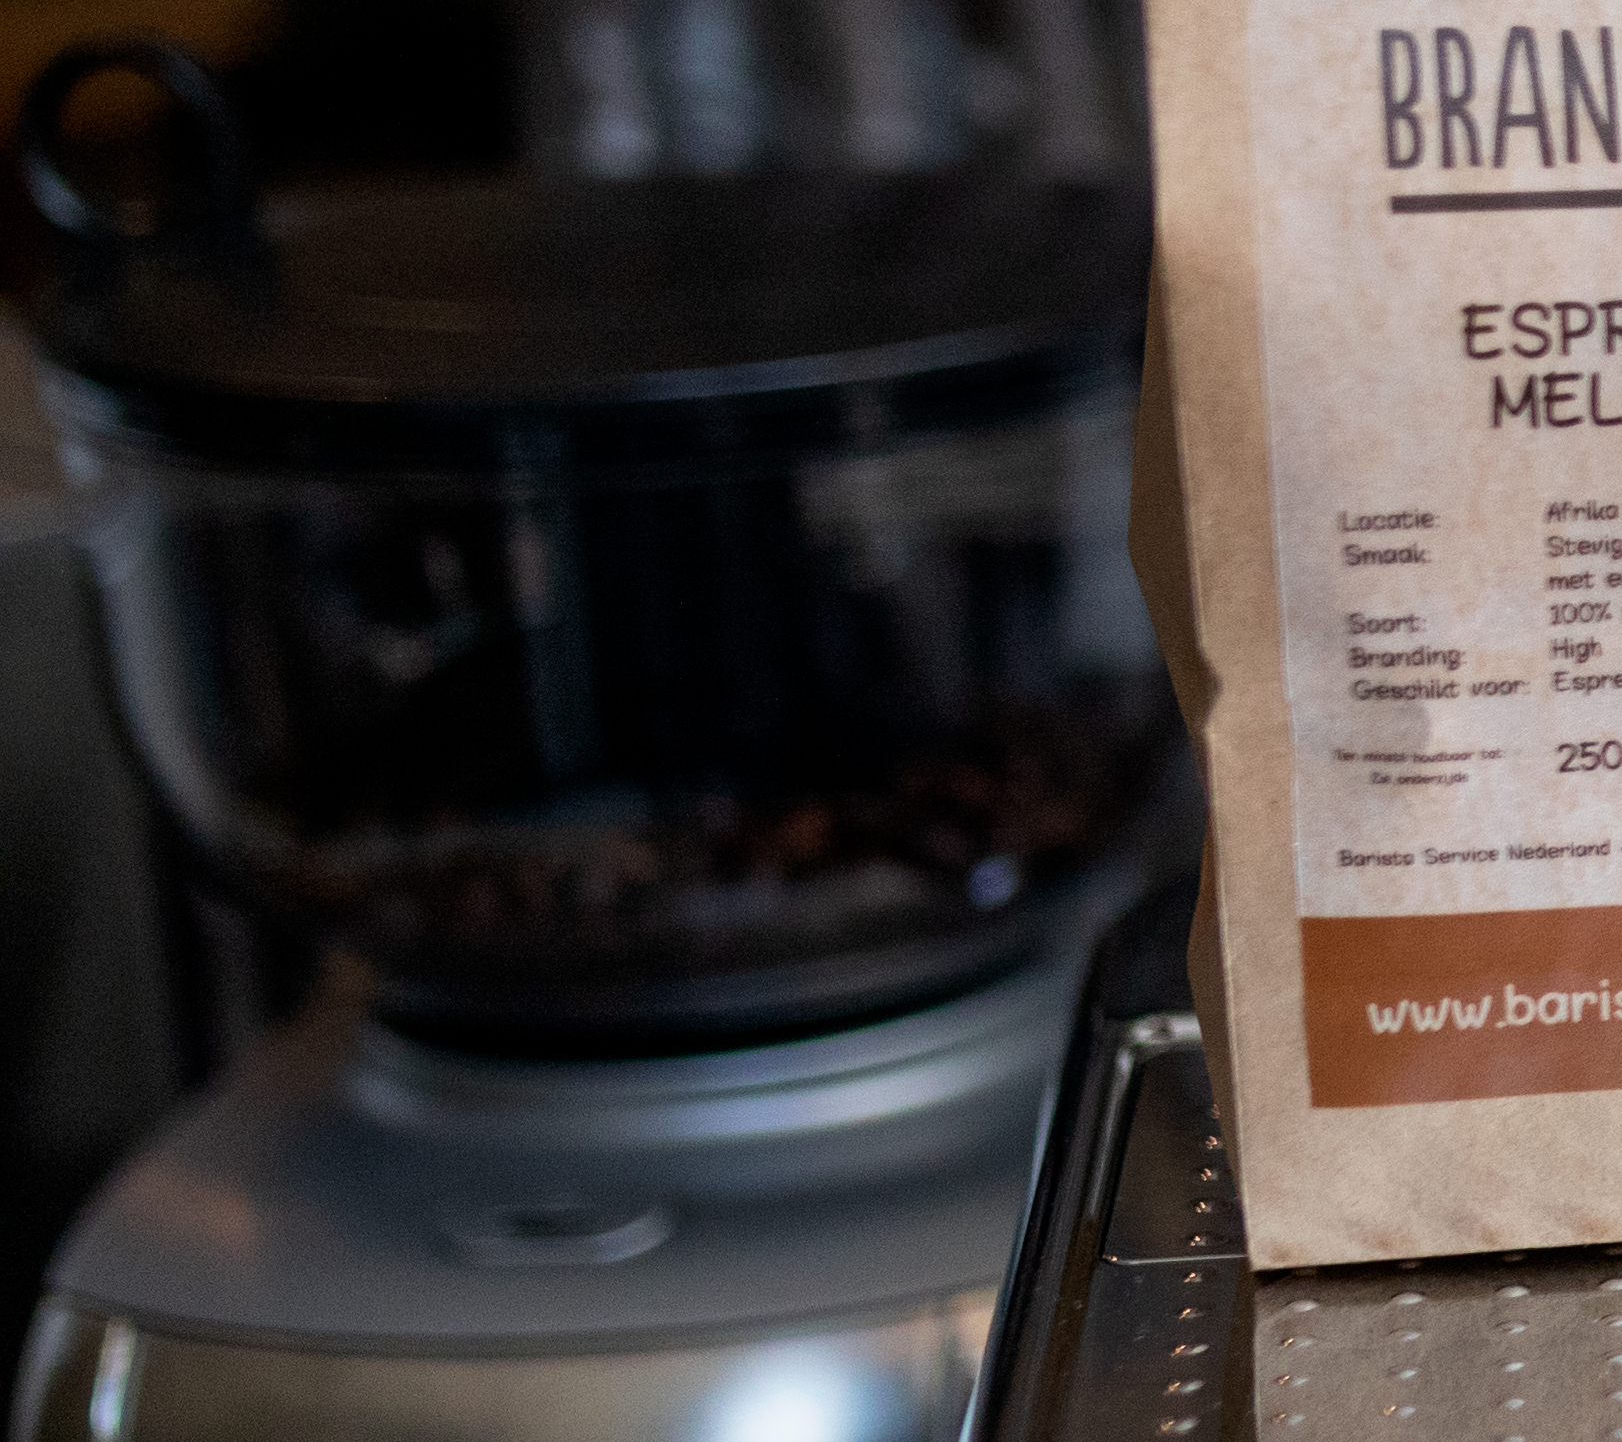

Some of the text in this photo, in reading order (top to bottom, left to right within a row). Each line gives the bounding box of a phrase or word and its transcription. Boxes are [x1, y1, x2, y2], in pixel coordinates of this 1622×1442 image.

[1338, 510, 1440, 533] Locatie:
[1546, 500, 1620, 523] Afrika
[1547, 570, 1596, 590] met
[1549, 601, 1613, 626] 100%
[1348, 645, 1466, 672] Branding:
[1551, 635, 1603, 665] High
[1337, 848, 1415, 868] Barista
[1422, 846, 1500, 867] Service
[1506, 838, 1612, 861] Nederland
